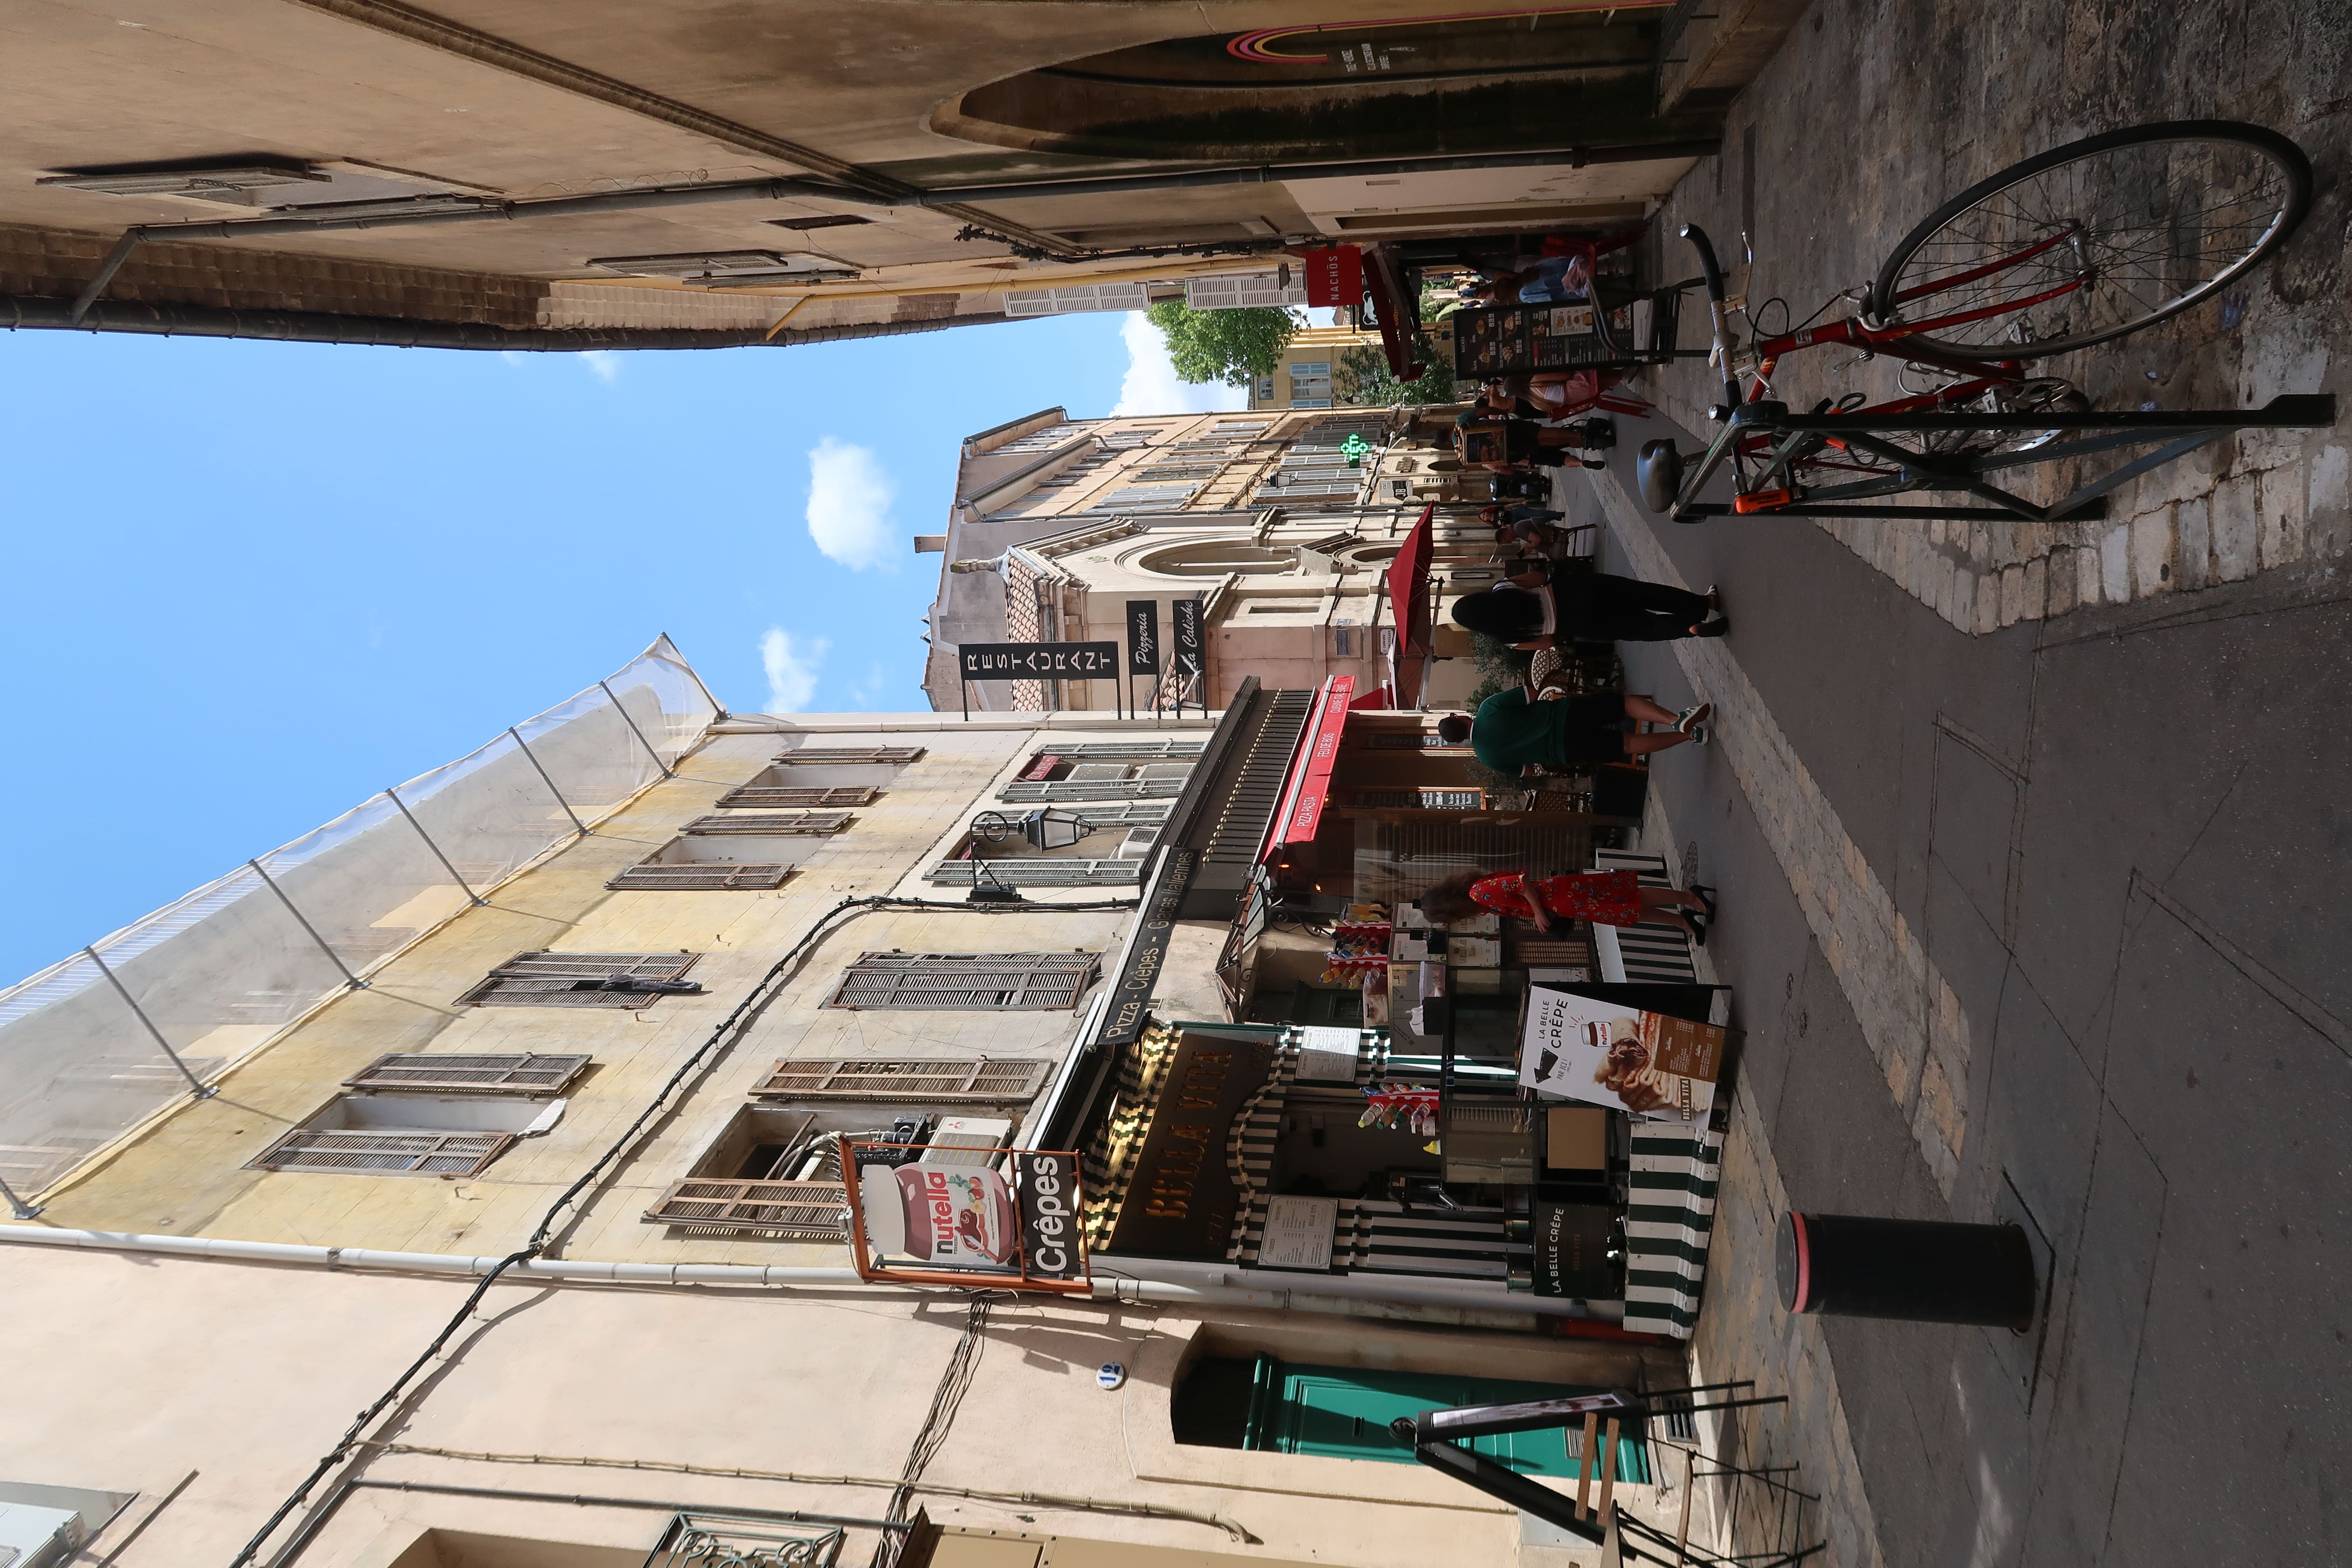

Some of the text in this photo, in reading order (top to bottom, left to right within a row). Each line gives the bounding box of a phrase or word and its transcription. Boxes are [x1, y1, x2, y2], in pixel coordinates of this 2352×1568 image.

[1135, 612, 1153, 664] Pizzeria
[1180, 601, 1197, 647] Calèche
[968, 650, 1110, 671] RESTAURANT
[1317, 749, 1331, 757] FEU
[1321, 733, 1335, 742] BOIS
[1296, 796, 1317, 827] PIZZA PASTA
[1161, 852, 1194, 894] Italiennes
[1148, 897, 1178, 929] Glaces
[1125, 948, 1160, 989] Crêpes
[1106, 1002, 1141, 1038] Pizza
[1538, 1000, 1550, 1039] LA BELLE
[1549, 999, 1568, 1048] CRÊPE
[1600, 1023, 1608, 1045] nutella
[1556, 1071, 1565, 1080] PAR
[1559, 1062, 1567, 1070] ICI
[1143, 1051, 1231, 1219] BELLA VITA
[926, 1172, 954, 1255] nutella
[1032, 1157, 1070, 1271] Crêpes
[1549, 1208, 1564, 1293] LA BELLE CRÊPE
[1099, 1364, 1120, 1382] 12
